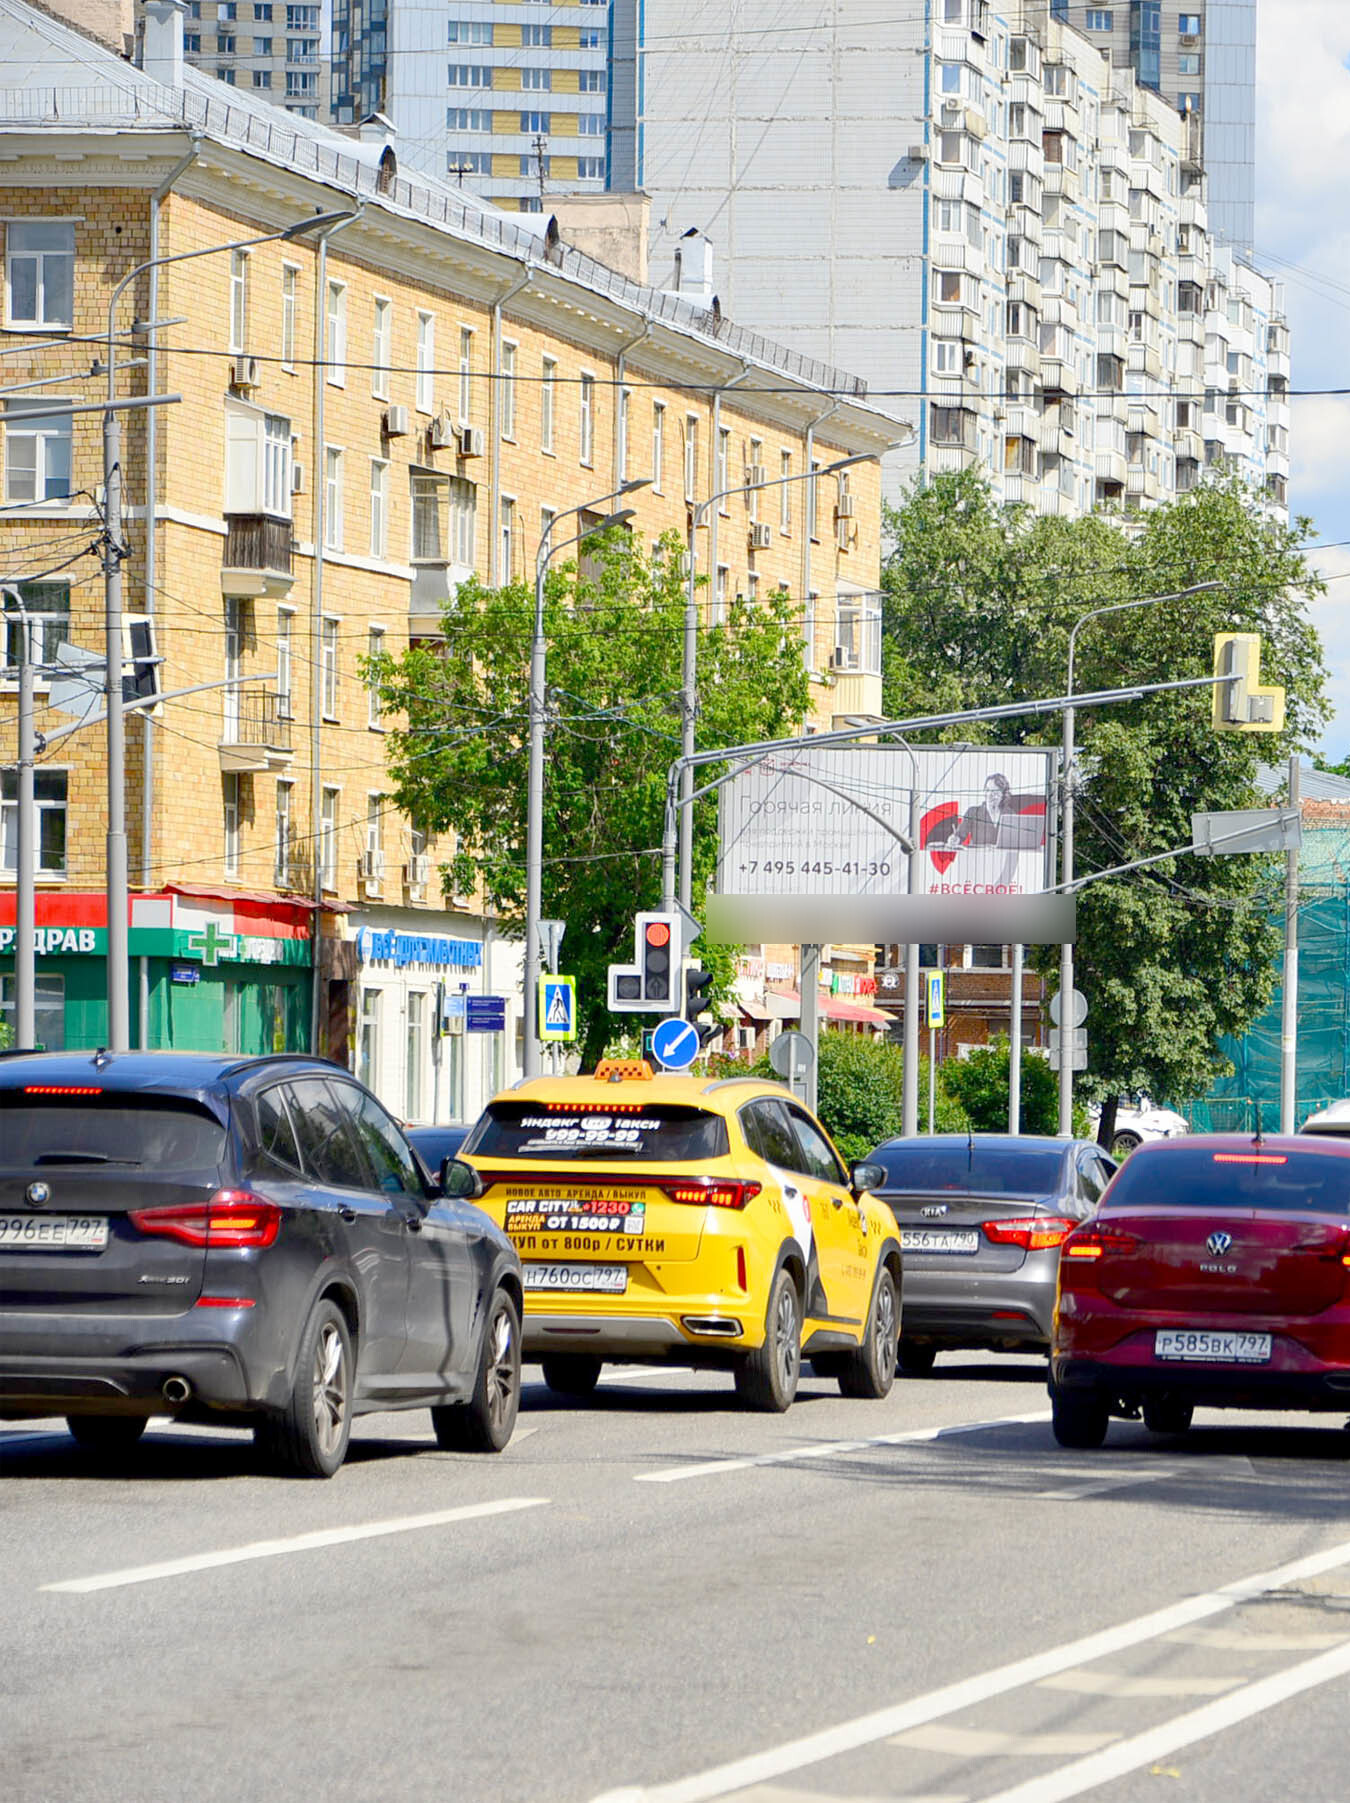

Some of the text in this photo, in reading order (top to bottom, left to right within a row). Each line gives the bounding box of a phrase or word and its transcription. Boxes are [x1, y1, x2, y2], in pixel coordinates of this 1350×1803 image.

[741, 796, 892, 818] Горячая линия
[739, 861, 891, 876] +7 495 445-41-30
[506, 1188, 535, 1198] НОВОЕ
[538, 1188, 561, 1198] АВТО
[566, 1190, 604, 1199] АРЕНДА
[507, 1201, 569, 1213] CAR CITY
[923, 1207, 943, 1217] KIA
[508, 1214, 546, 1223] АРЕНДА
[547, 1217, 568, 1229] ОТ
[69, 1219, 101, 1237] 797
[542, 1238, 558, 1249] от
[564, 1237, 601, 1251] 800р
[617, 1238, 665, 1251] СУТКИ
[1200, 1263, 1237, 1273] POLO
[594, 1268, 621, 1282] 797
[1238, 1335, 1267, 1350] 797
